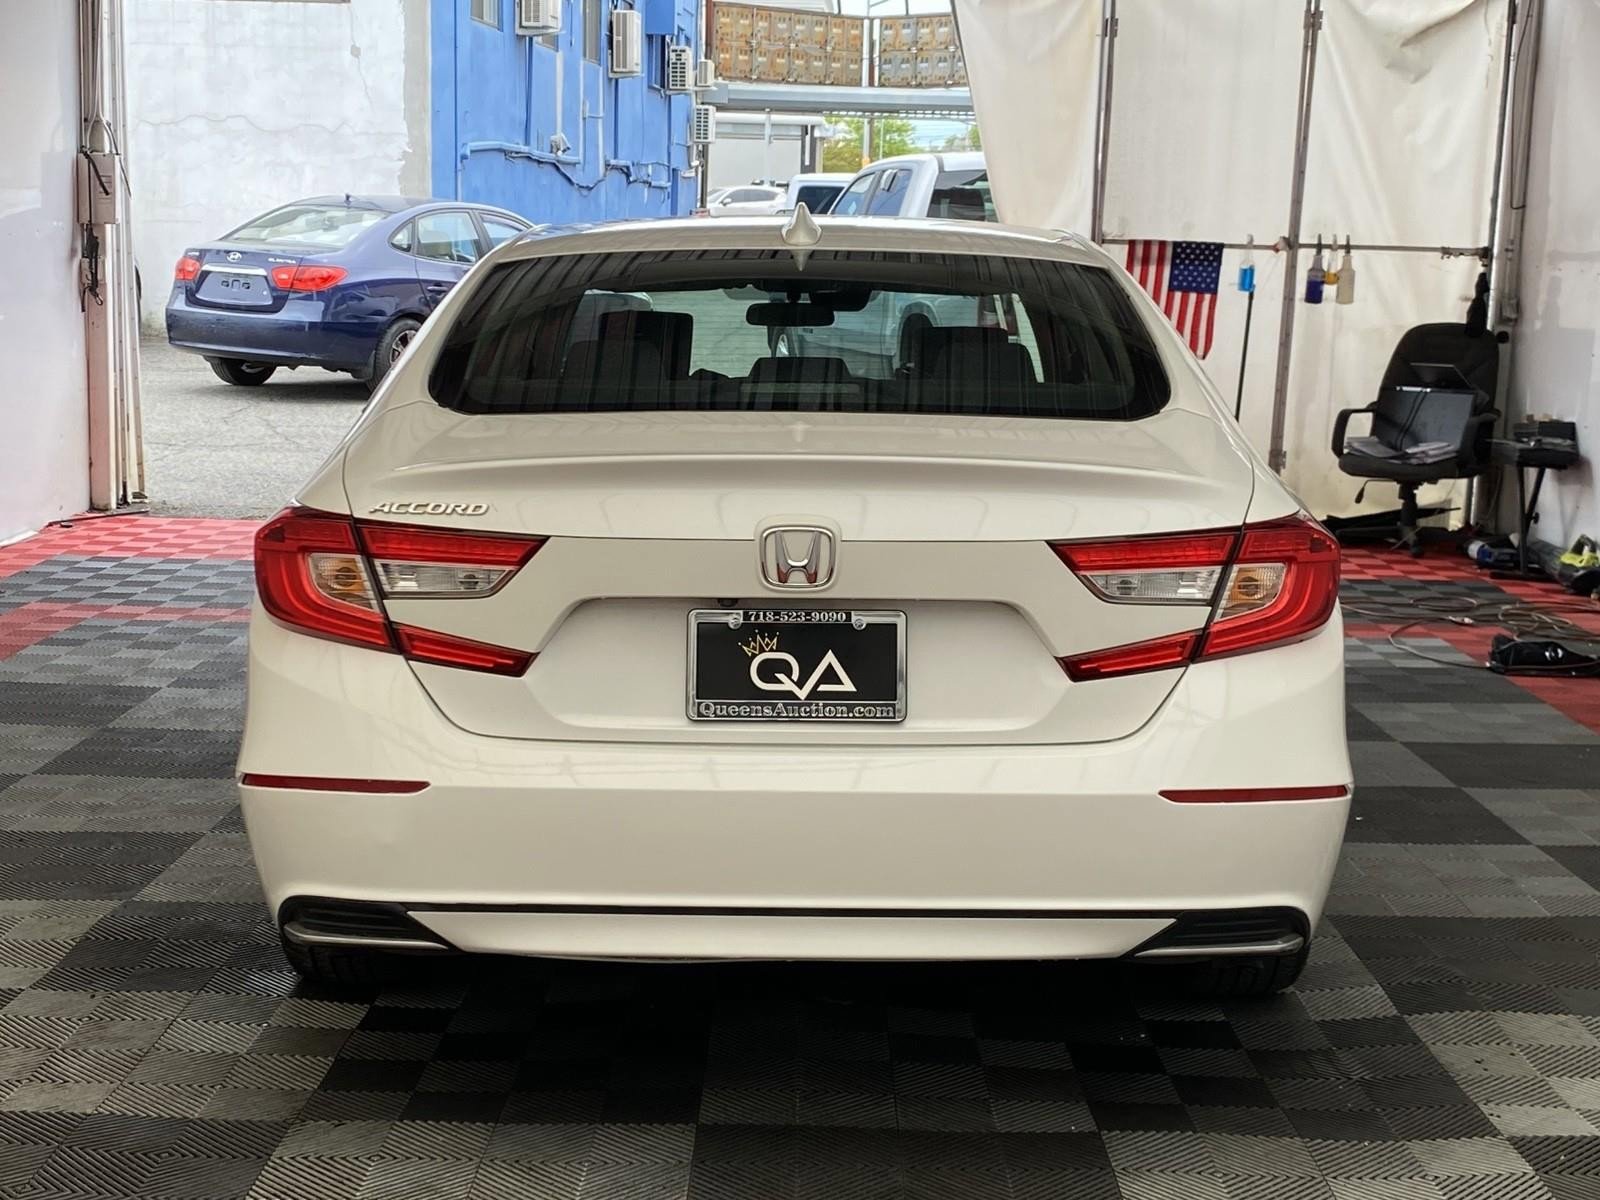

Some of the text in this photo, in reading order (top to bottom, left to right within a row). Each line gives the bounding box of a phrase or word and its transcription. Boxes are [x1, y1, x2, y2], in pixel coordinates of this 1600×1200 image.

[369, 502, 489, 516] ACCORD
[749, 611, 846, 622] 718-523-9090
[750, 650, 857, 700] QA
[699, 702, 895, 718] QueensAuction.com
